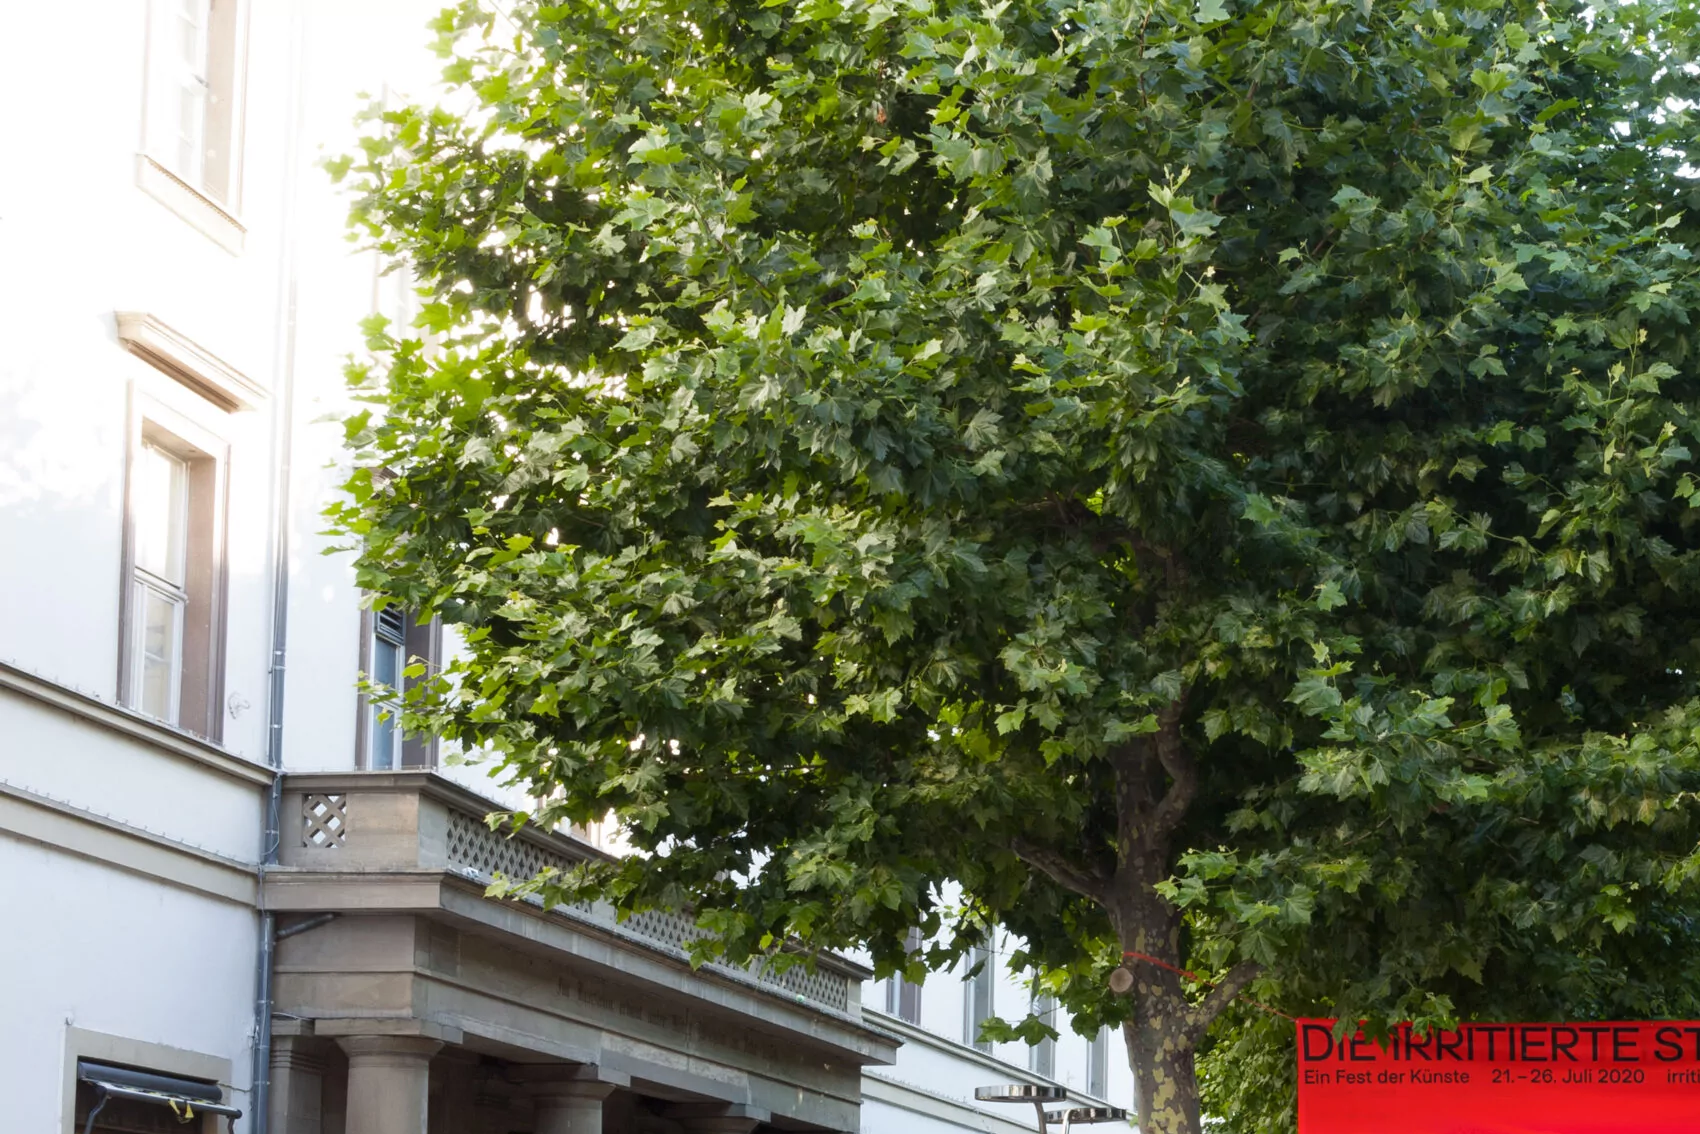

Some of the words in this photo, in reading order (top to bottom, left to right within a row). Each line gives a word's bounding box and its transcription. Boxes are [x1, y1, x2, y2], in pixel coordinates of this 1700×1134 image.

[1393, 1026, 1640, 1062] IRRITIERTE
[1304, 1069, 1330, 1085] Ein
[1336, 1069, 1372, 1084] Fest
[1377, 1069, 1404, 1084] der
[1410, 1068, 1470, 1084] Künste
[1562, 1068, 1593, 1084] Juli
[1597, 1069, 1645, 1084] 2020
